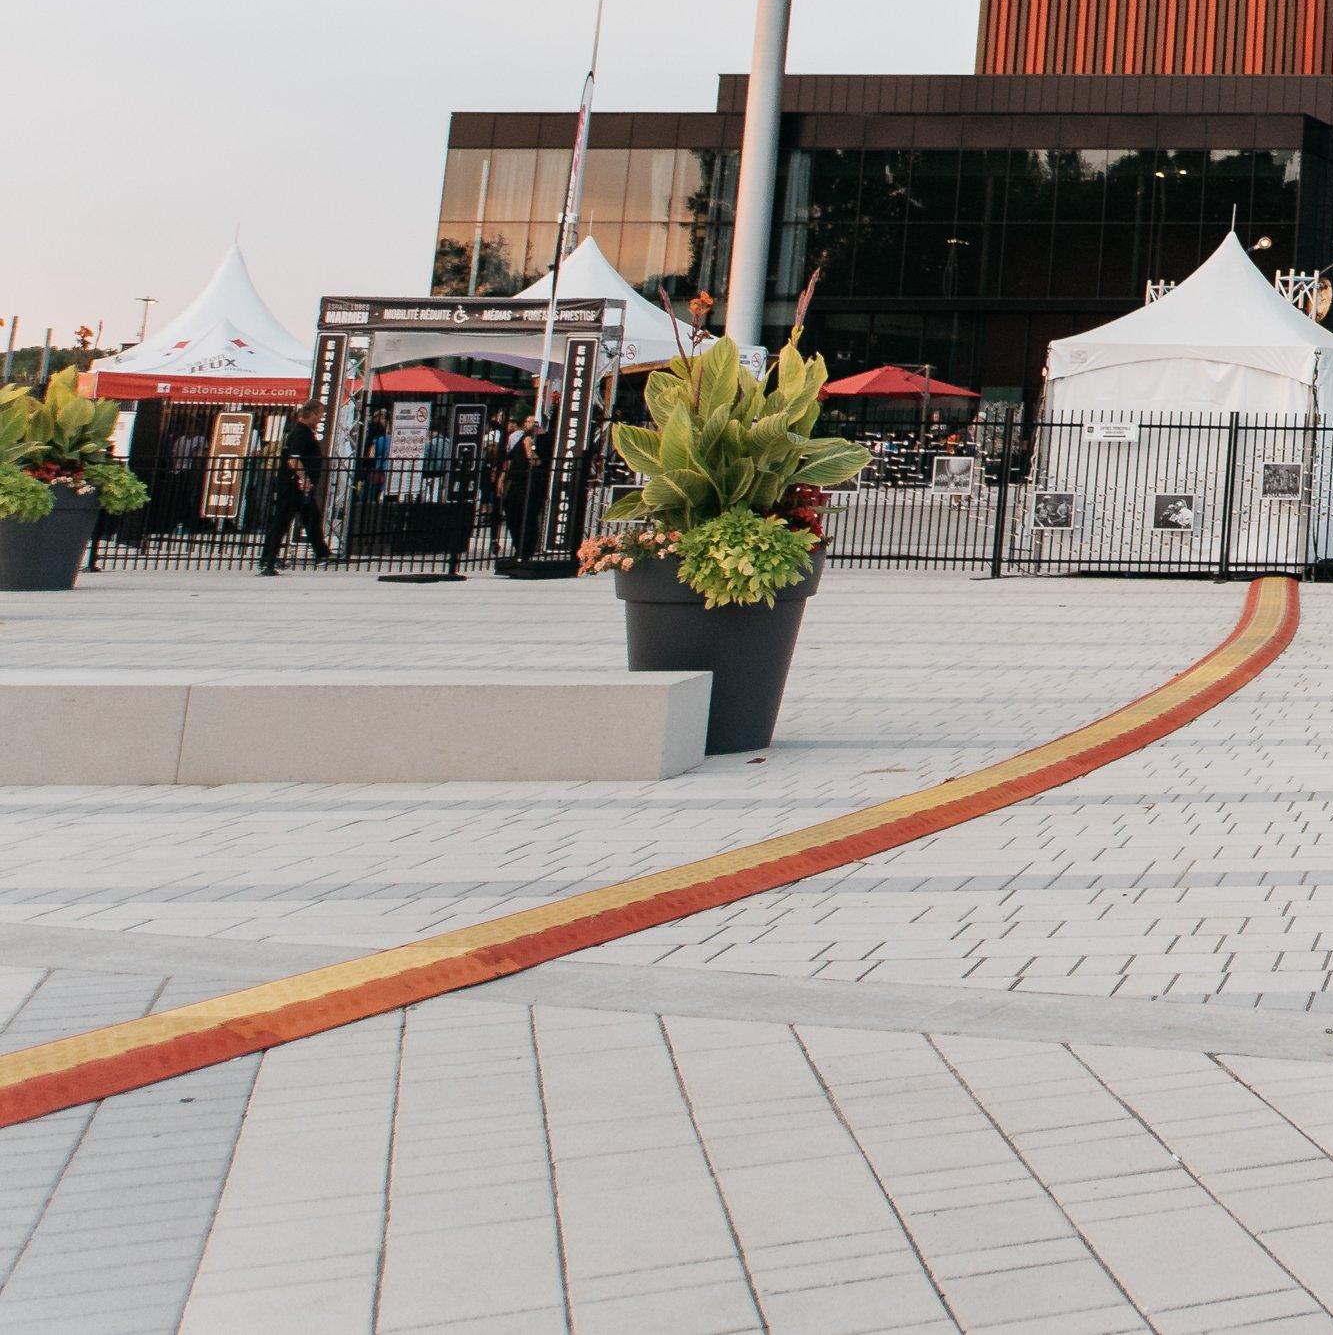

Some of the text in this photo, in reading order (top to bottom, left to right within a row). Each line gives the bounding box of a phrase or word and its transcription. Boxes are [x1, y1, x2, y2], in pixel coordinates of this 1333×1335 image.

[324, 311, 370, 324] MARMEN
[383, 307, 452, 321] MOBILITÉ RÉDUITE
[482, 308, 513, 321] MÉDIAS
[559, 310, 597, 322] PRESTIGE
[320, 340, 336, 406] ENTRÉE
[570, 345, 586, 412] ENTRÉE
[182, 385, 297, 399] salonsdejeux.com
[459, 412, 481, 424] ENTRÉE
[562, 417, 579, 482] ESPACE
